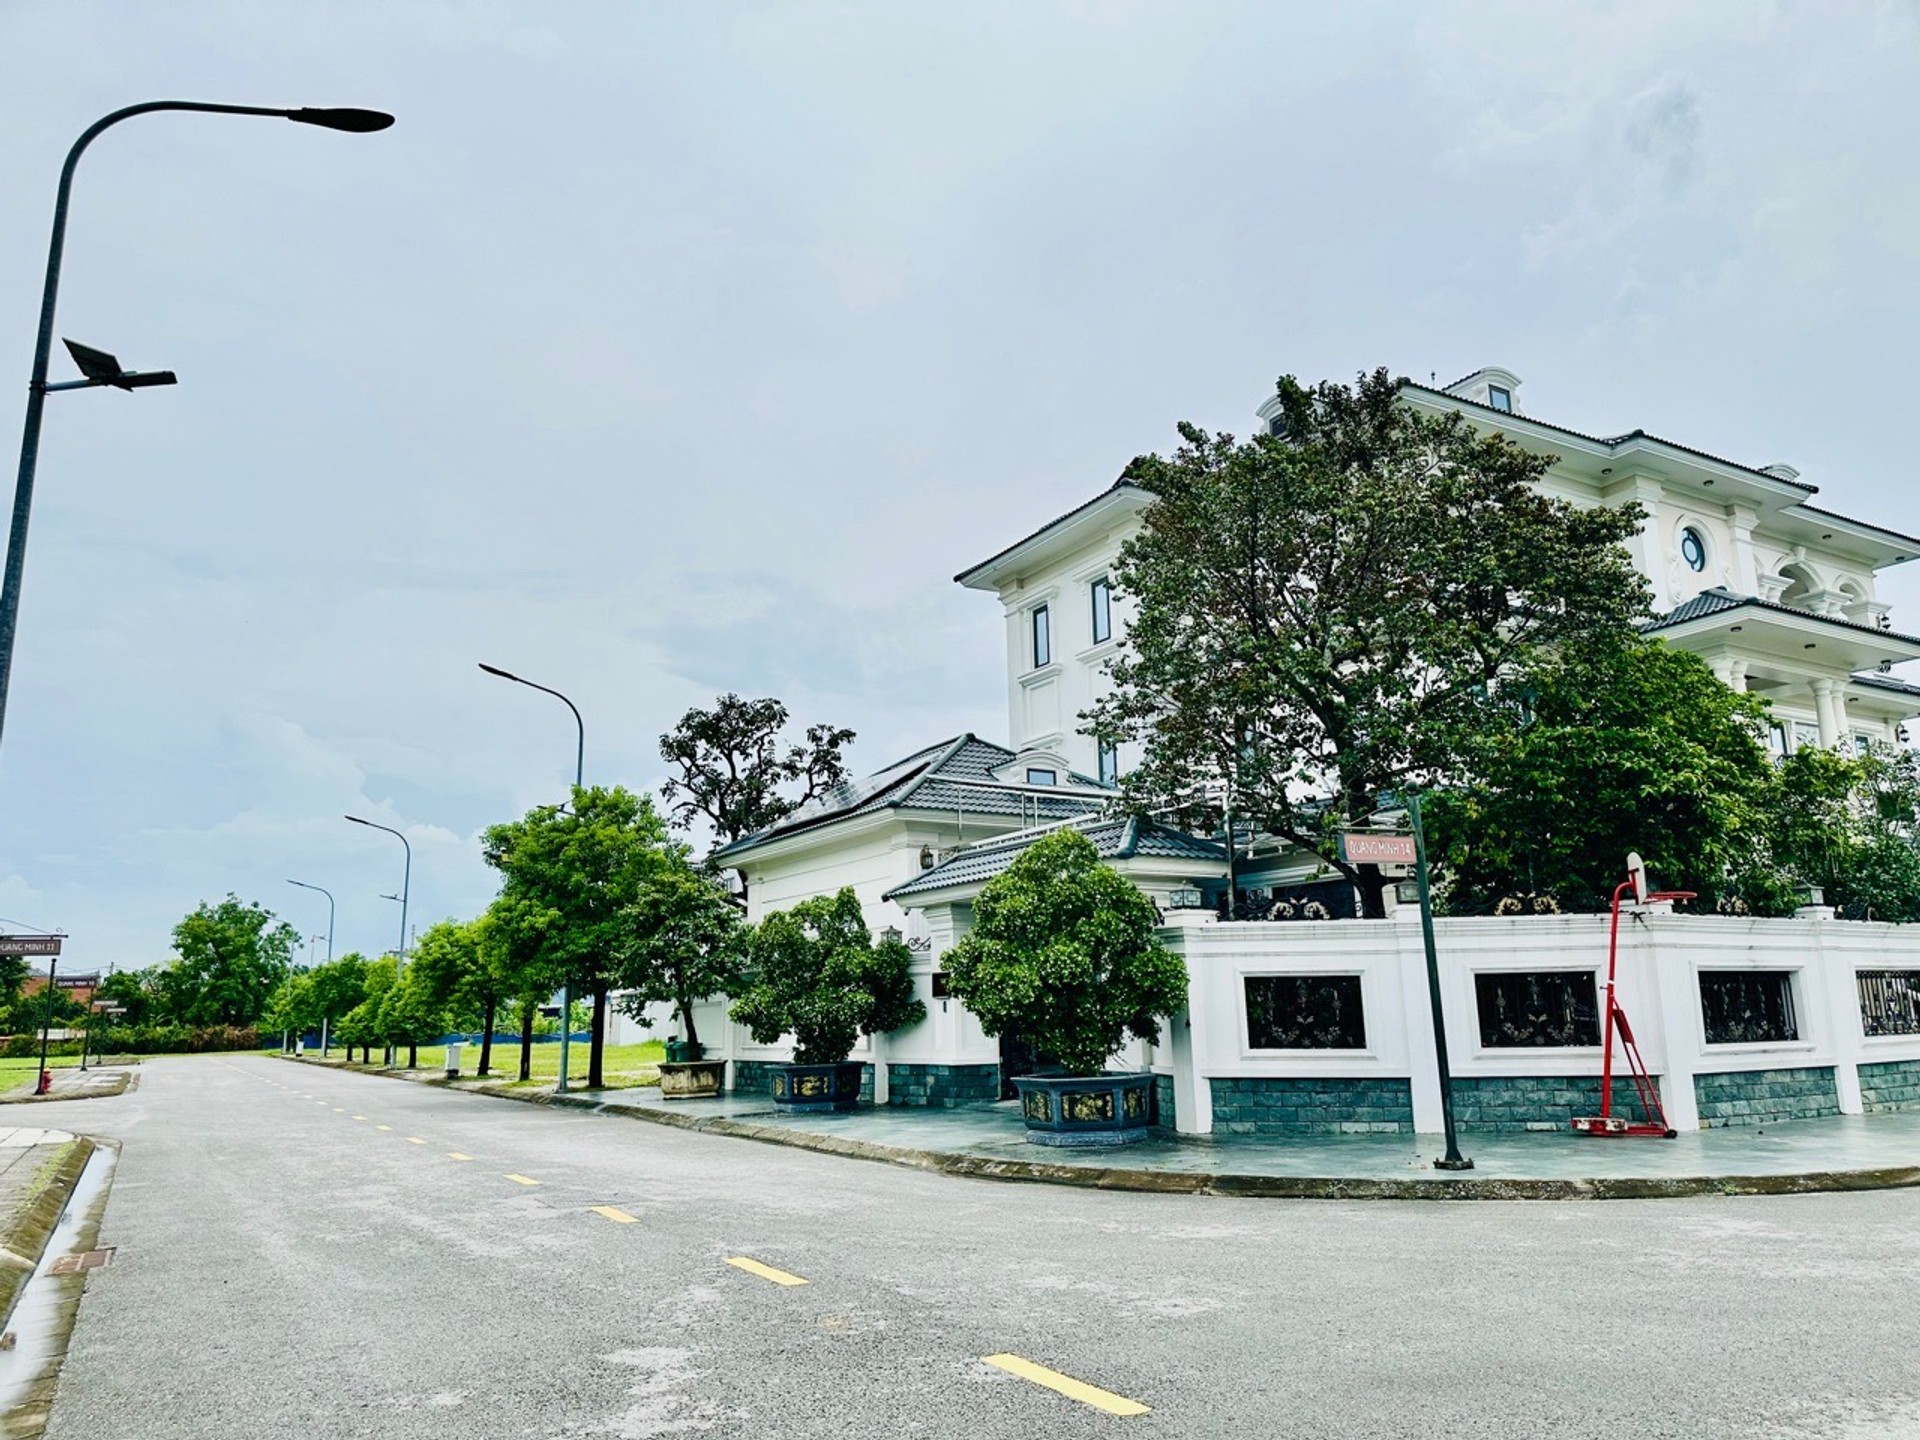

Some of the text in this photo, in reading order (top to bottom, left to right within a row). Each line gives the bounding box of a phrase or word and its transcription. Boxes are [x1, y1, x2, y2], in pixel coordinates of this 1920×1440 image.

[1349, 840, 1378, 856] QUANG
[1378, 841, 1399, 855] MINH
[0, 943, 24, 951] UANG
[25, 943, 45, 951] MINH
